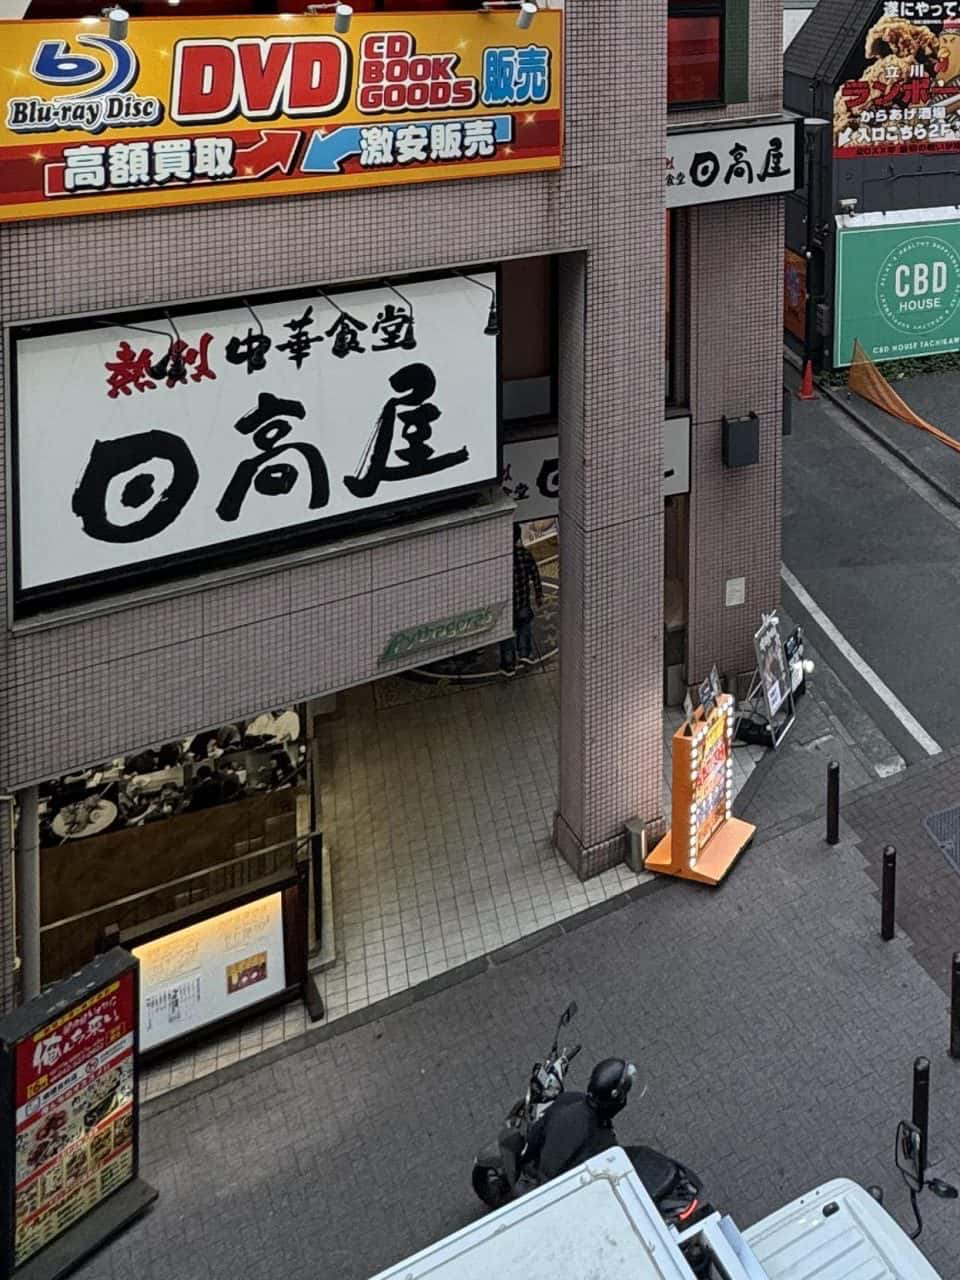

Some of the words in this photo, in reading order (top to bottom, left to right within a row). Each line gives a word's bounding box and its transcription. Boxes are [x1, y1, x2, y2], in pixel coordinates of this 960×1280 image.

[364, 35, 410, 58] CD
[175, 39, 343, 117] DVD
[363, 57, 453, 84] BOOK
[483, 48, 549, 102] 販売
[10, 100, 101, 126] Blu-ray
[107, 96, 155, 119] Disc
[360, 80, 474, 110] GOODS
[360, 120, 495, 165] 激安販売
[63, 138, 234, 190] 高額買取
[690, 137, 791, 187] 日高屋
[895, 261, 947, 297] CBD
[899, 297, 942, 312] HOUSE
[892, 343, 918, 351] HOUSE
[72, 363, 470, 543] 日高屋
